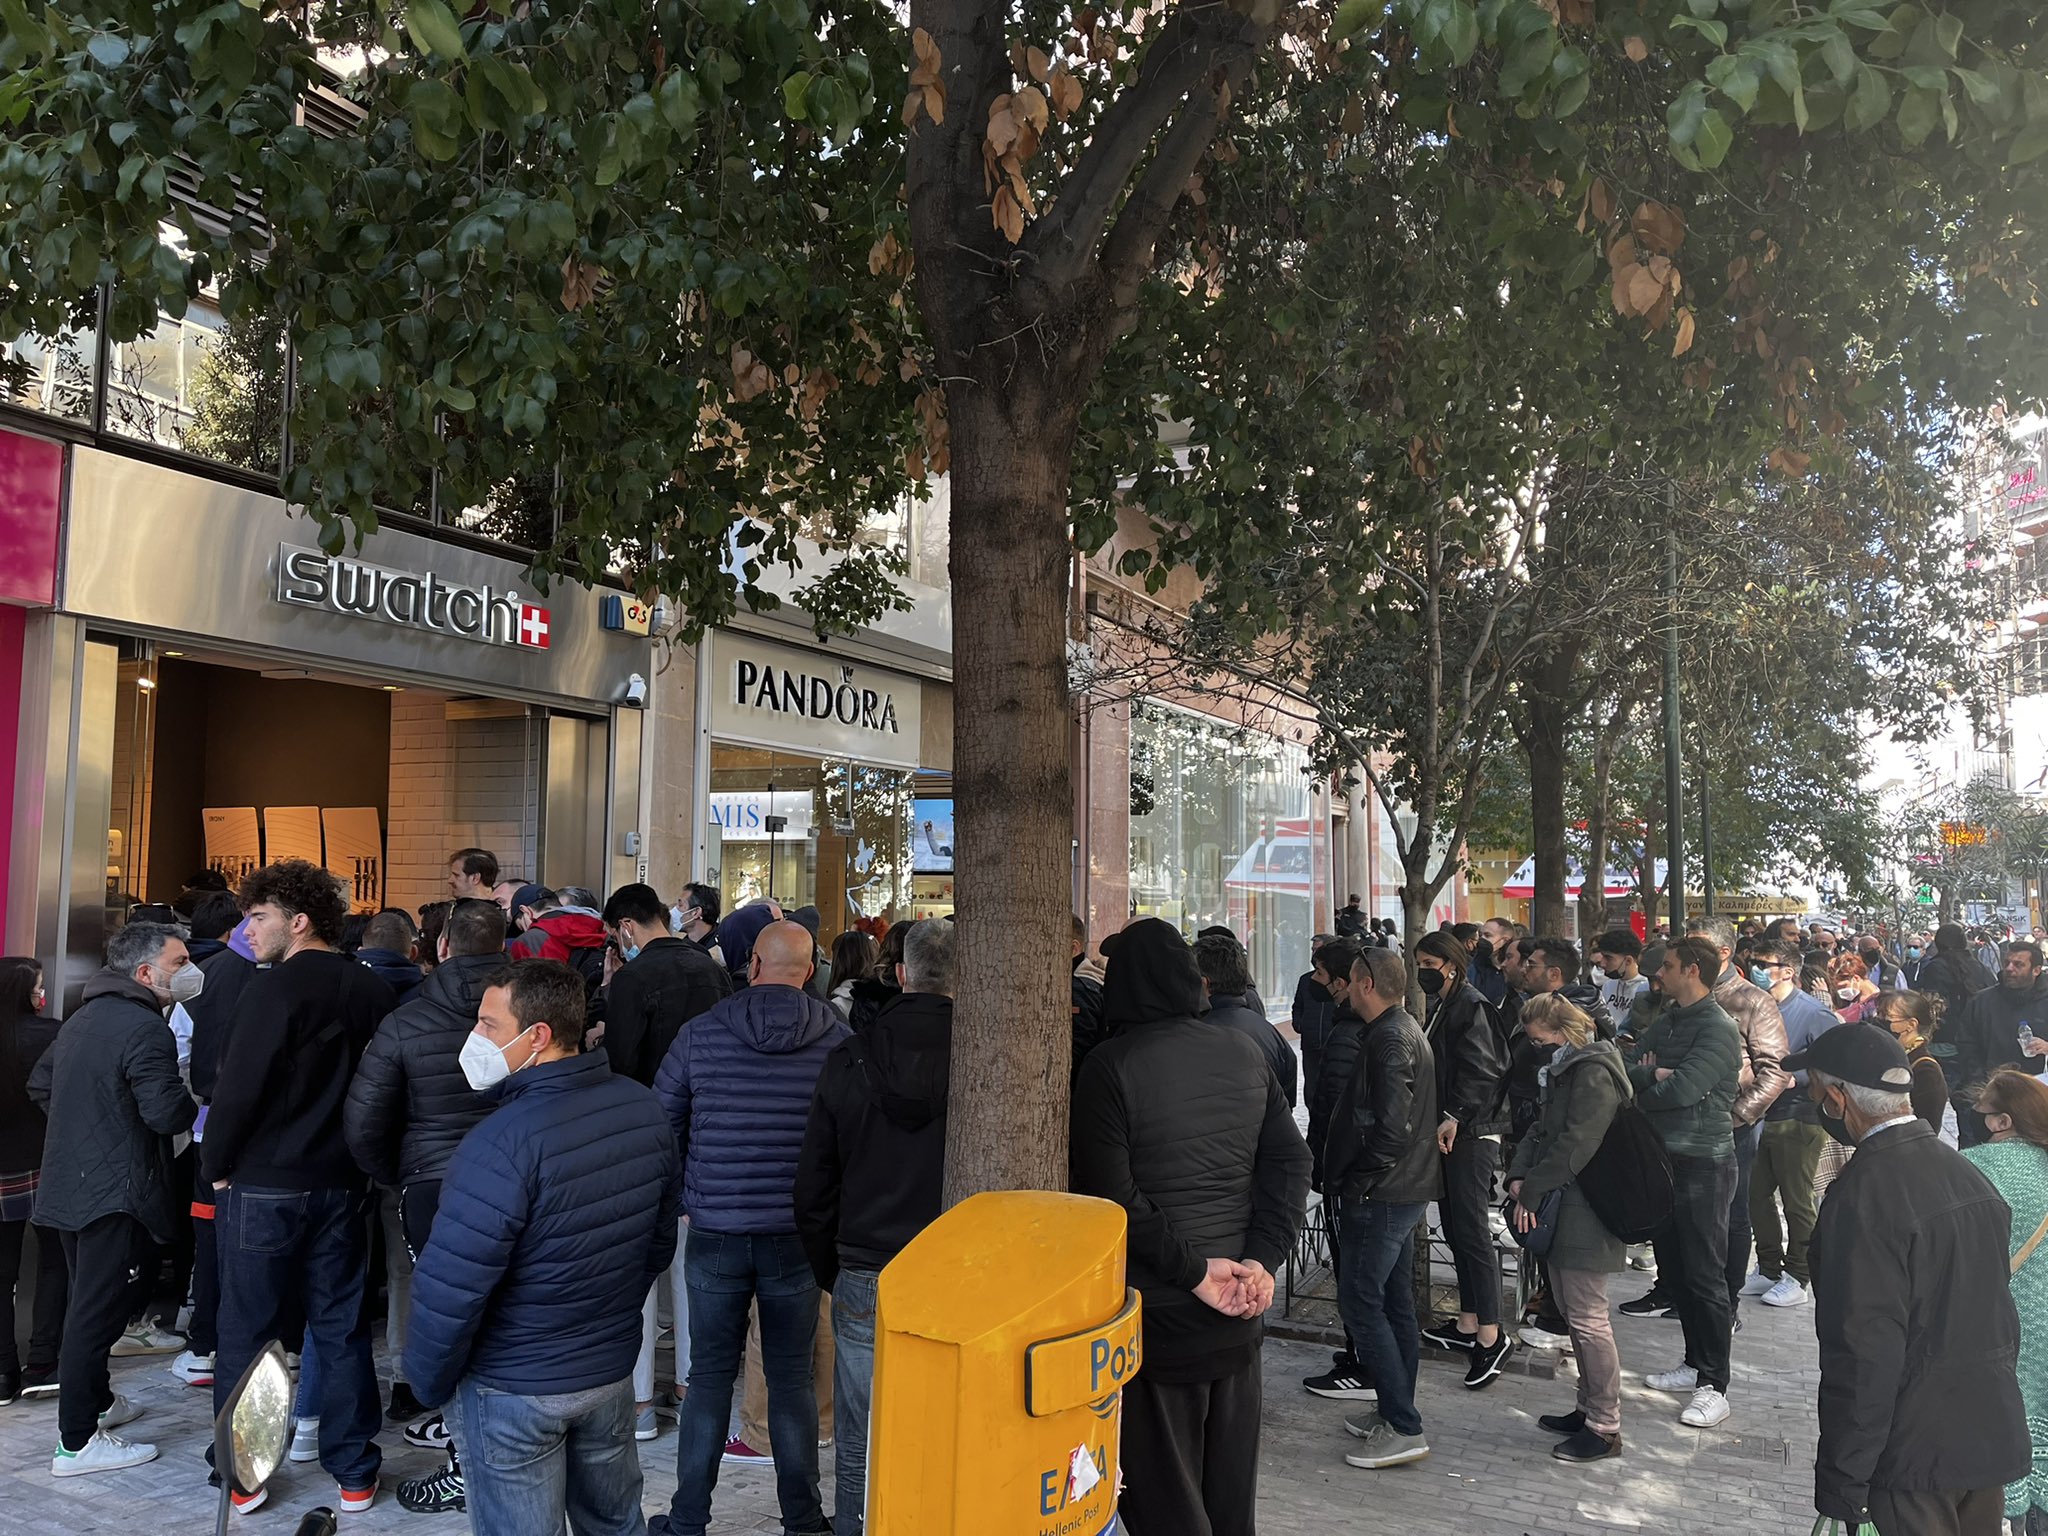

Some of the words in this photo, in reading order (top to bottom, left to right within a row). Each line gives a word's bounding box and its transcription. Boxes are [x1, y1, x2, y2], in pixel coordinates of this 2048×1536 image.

[286, 552, 515, 643] swatch
[736, 660, 899, 734] PANDORA
[1718, 897, 1774, 911] Καλημέρες
[1083, 1503, 1100, 1523] Post
